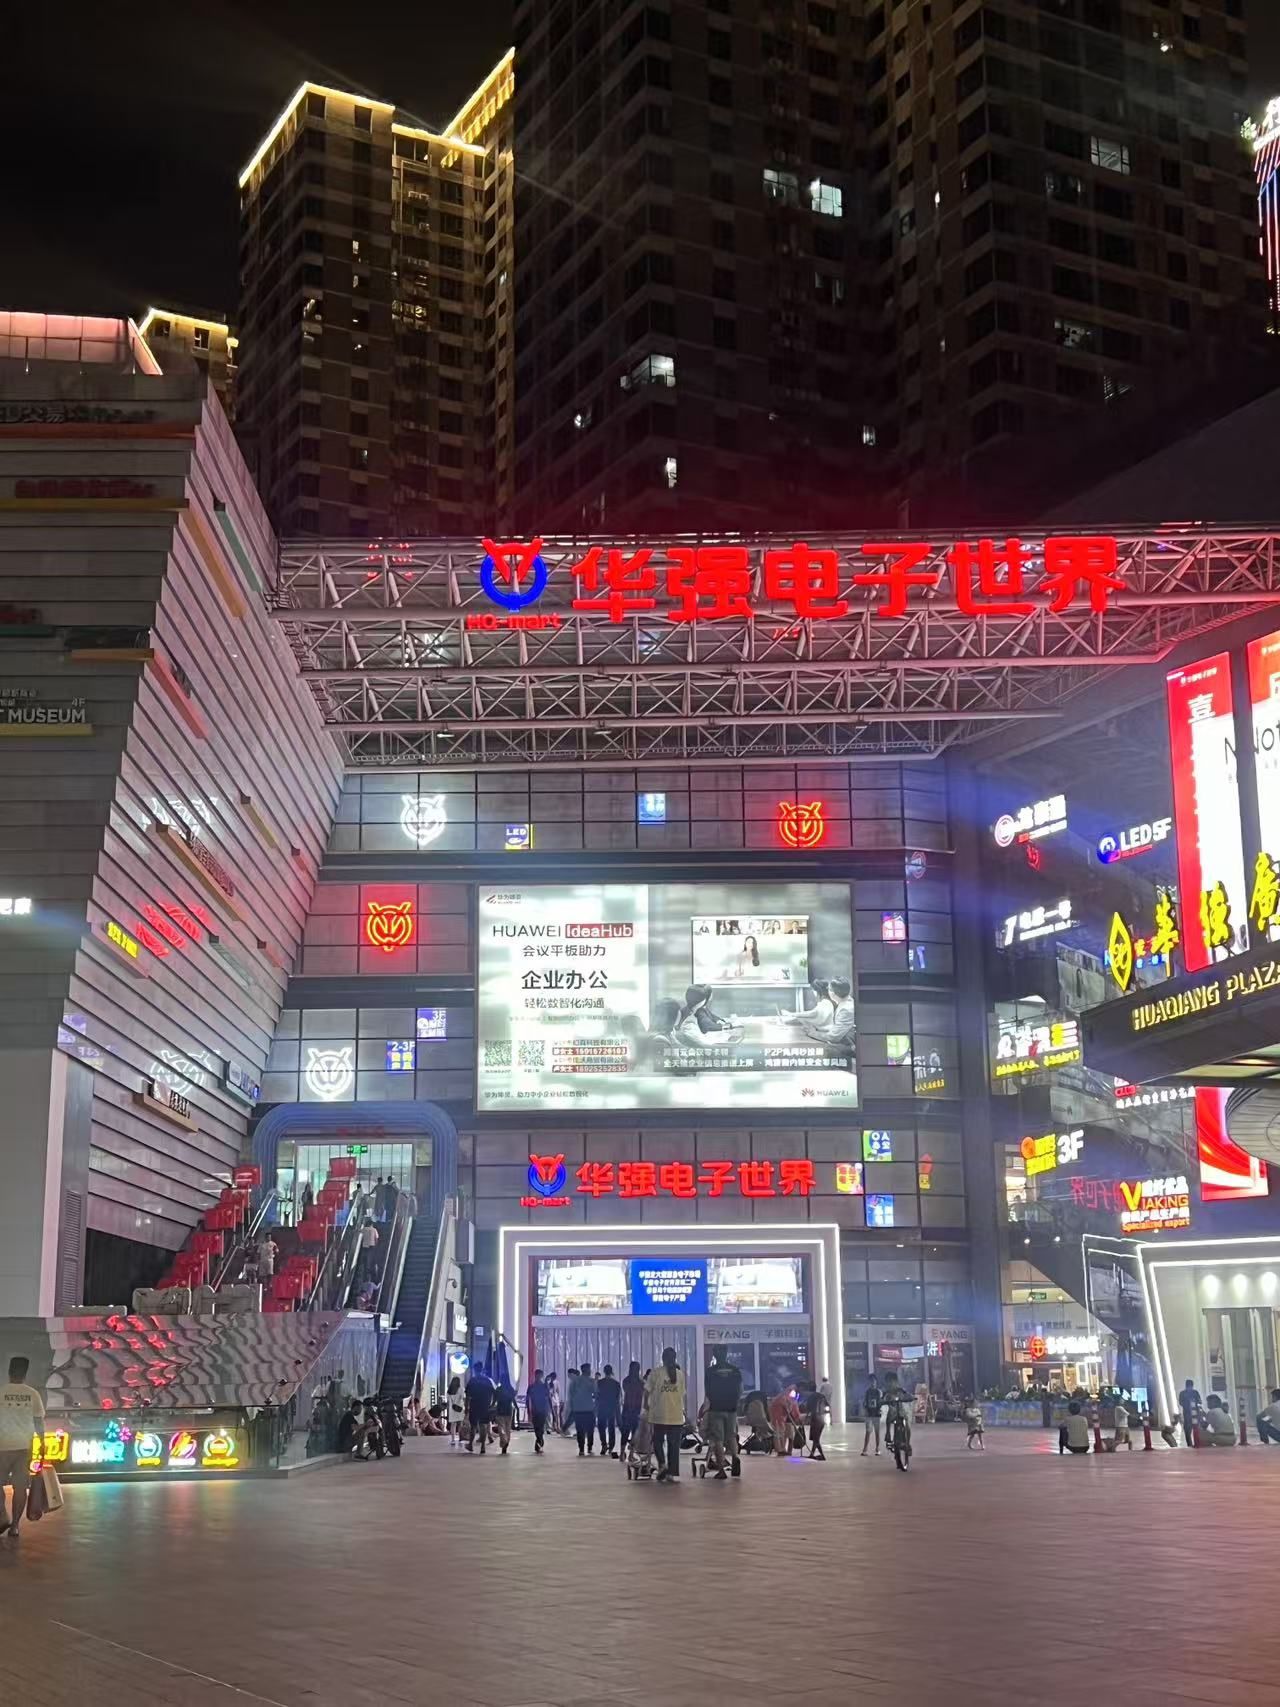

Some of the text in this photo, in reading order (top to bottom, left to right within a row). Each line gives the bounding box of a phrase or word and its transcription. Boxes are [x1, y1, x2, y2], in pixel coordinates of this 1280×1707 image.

[571, 536, 1126, 623] 华强电子世界
[8, 708, 86, 723] MUSEUM
[506, 828, 527, 836] LED
[1120, 824, 1152, 851] LED
[493, 924, 633, 938] HUAWEI IdeaHub
[523, 945, 606, 957] 会议平板助力
[521, 970, 608, 990] 企业办公
[524, 997, 605, 1009] 轻松数智化沟通
[1131, 981, 1221, 1031] HUAQIANG
[1057, 1129, 1084, 1164] 3F
[576, 1160, 816, 1198] 华强电子世界
[707, 1329, 751, 1339] EYANG
[931, 1328, 968, 1339] EYANG
